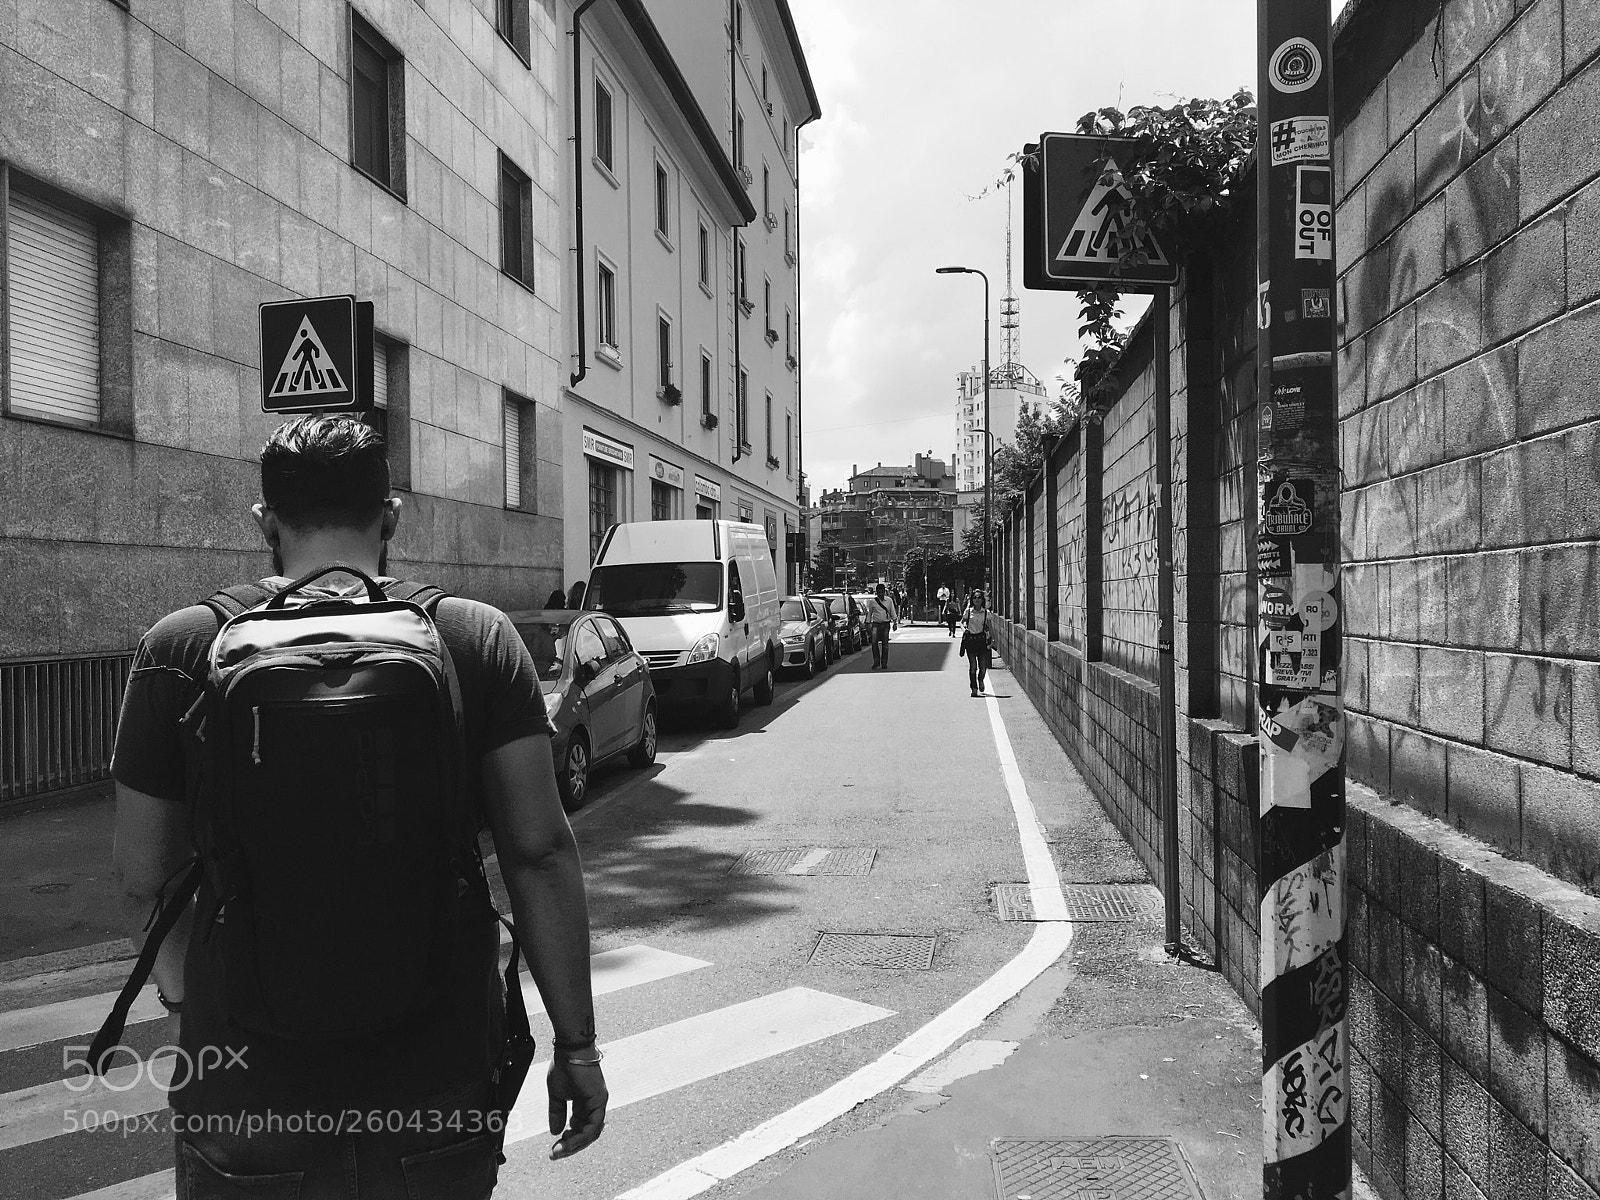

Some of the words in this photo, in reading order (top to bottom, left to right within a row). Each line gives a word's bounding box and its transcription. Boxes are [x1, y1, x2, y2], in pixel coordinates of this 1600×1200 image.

[1276, 149, 1292, 159] MON
[1299, 209, 1314, 254] OUT
[1317, 210, 1331, 241] OF
[1267, 513, 1309, 526] TRIBUNALE
